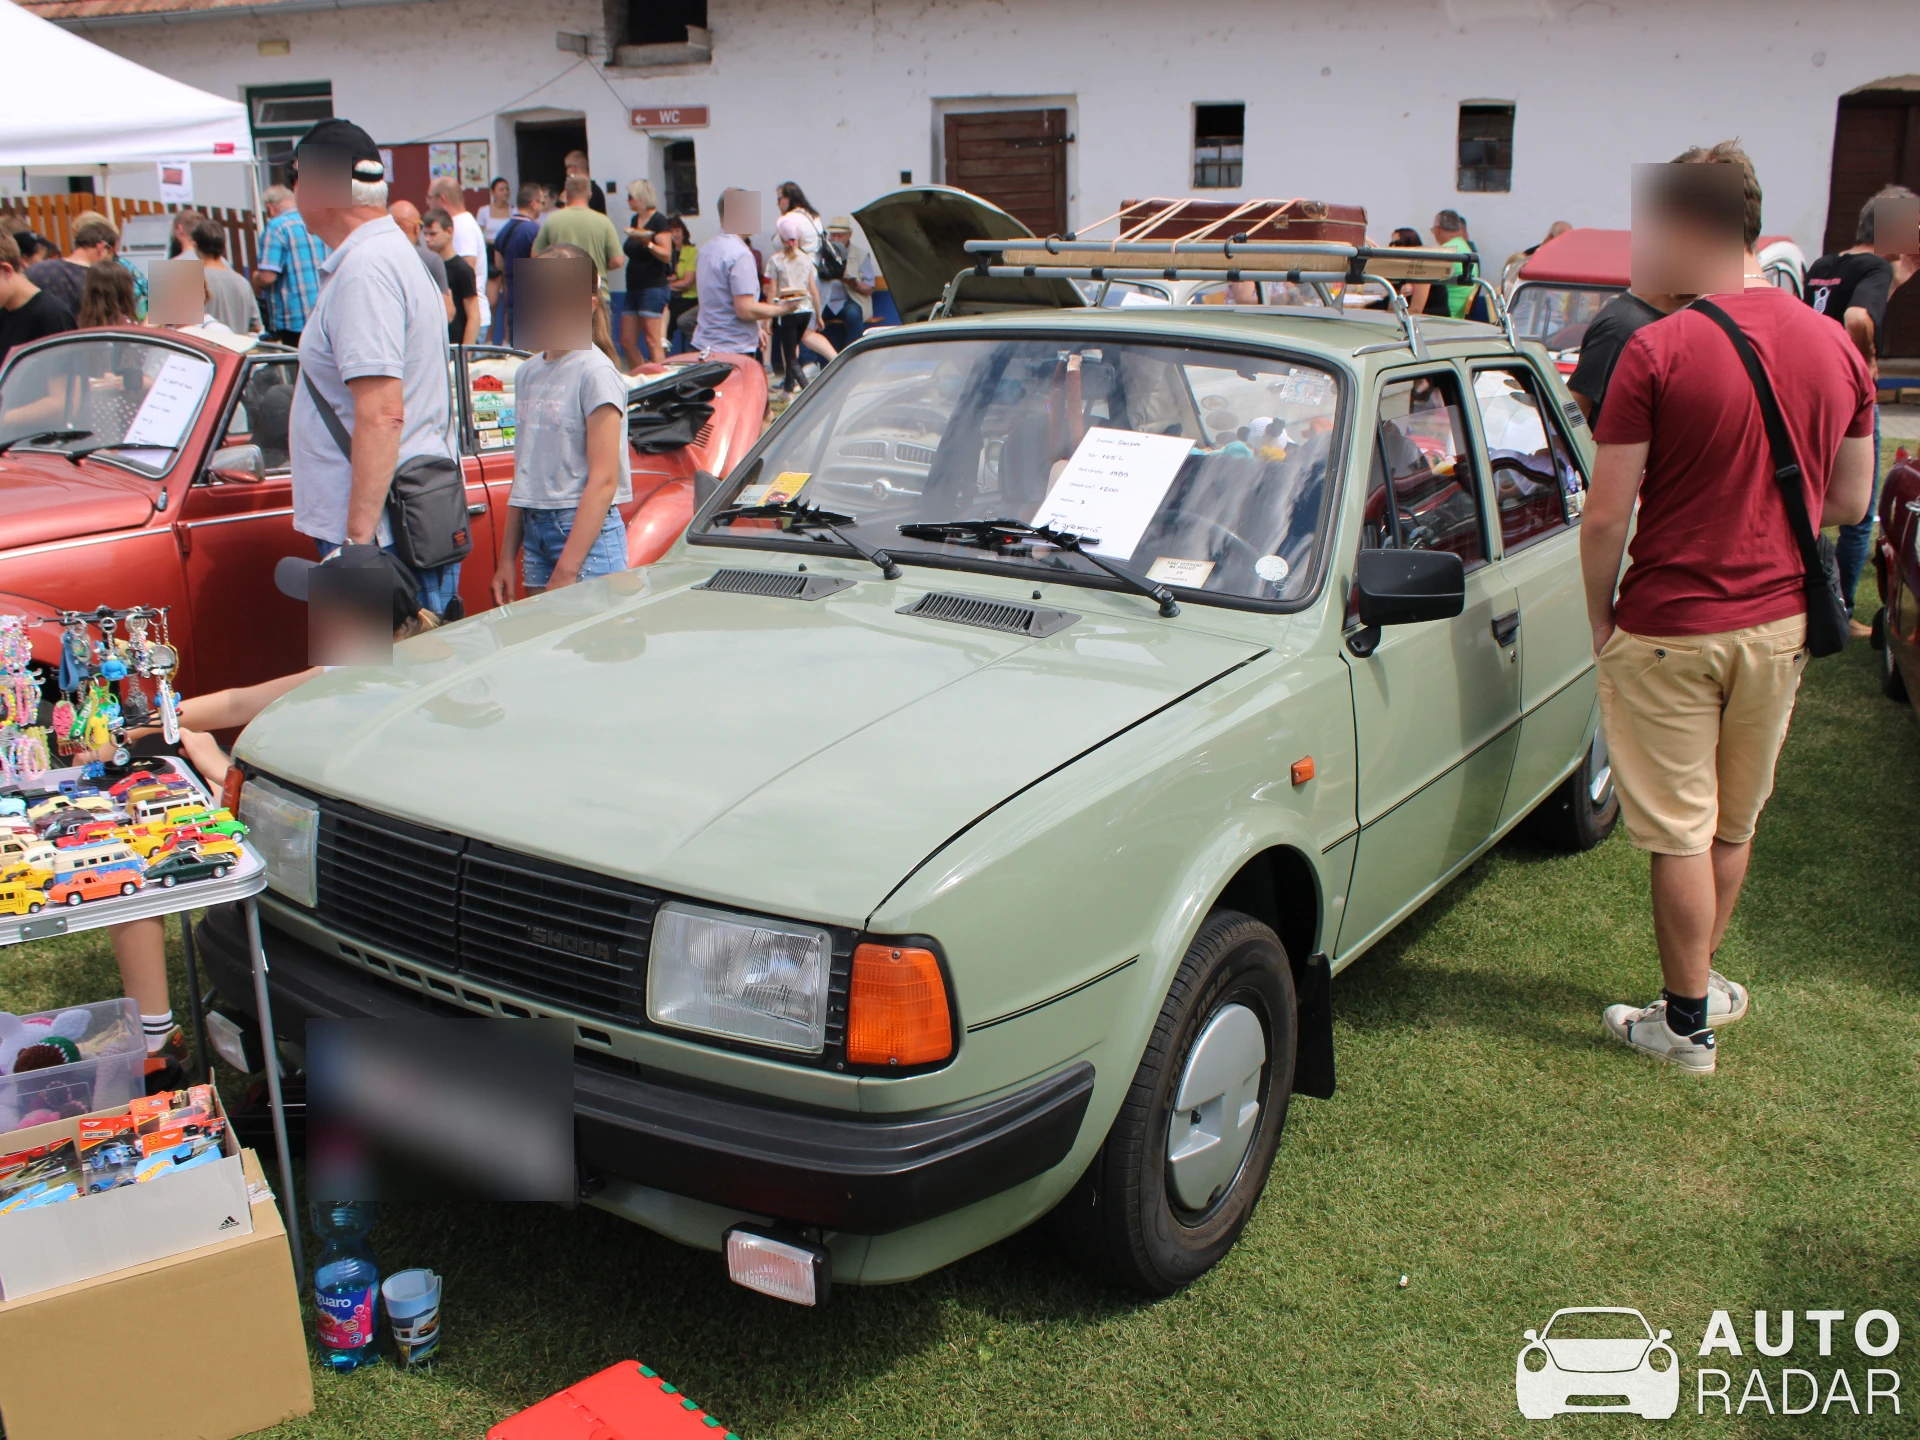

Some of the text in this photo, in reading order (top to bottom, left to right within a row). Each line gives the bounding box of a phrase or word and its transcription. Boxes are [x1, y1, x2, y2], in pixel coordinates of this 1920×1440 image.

[659, 109, 681, 124] WC
[1109, 470, 1129, 478] 1989
[1099, 485, 1119, 493] 1200
[219, 1221, 240, 1231] adidas
[316, 1293, 352, 1308] guaro
